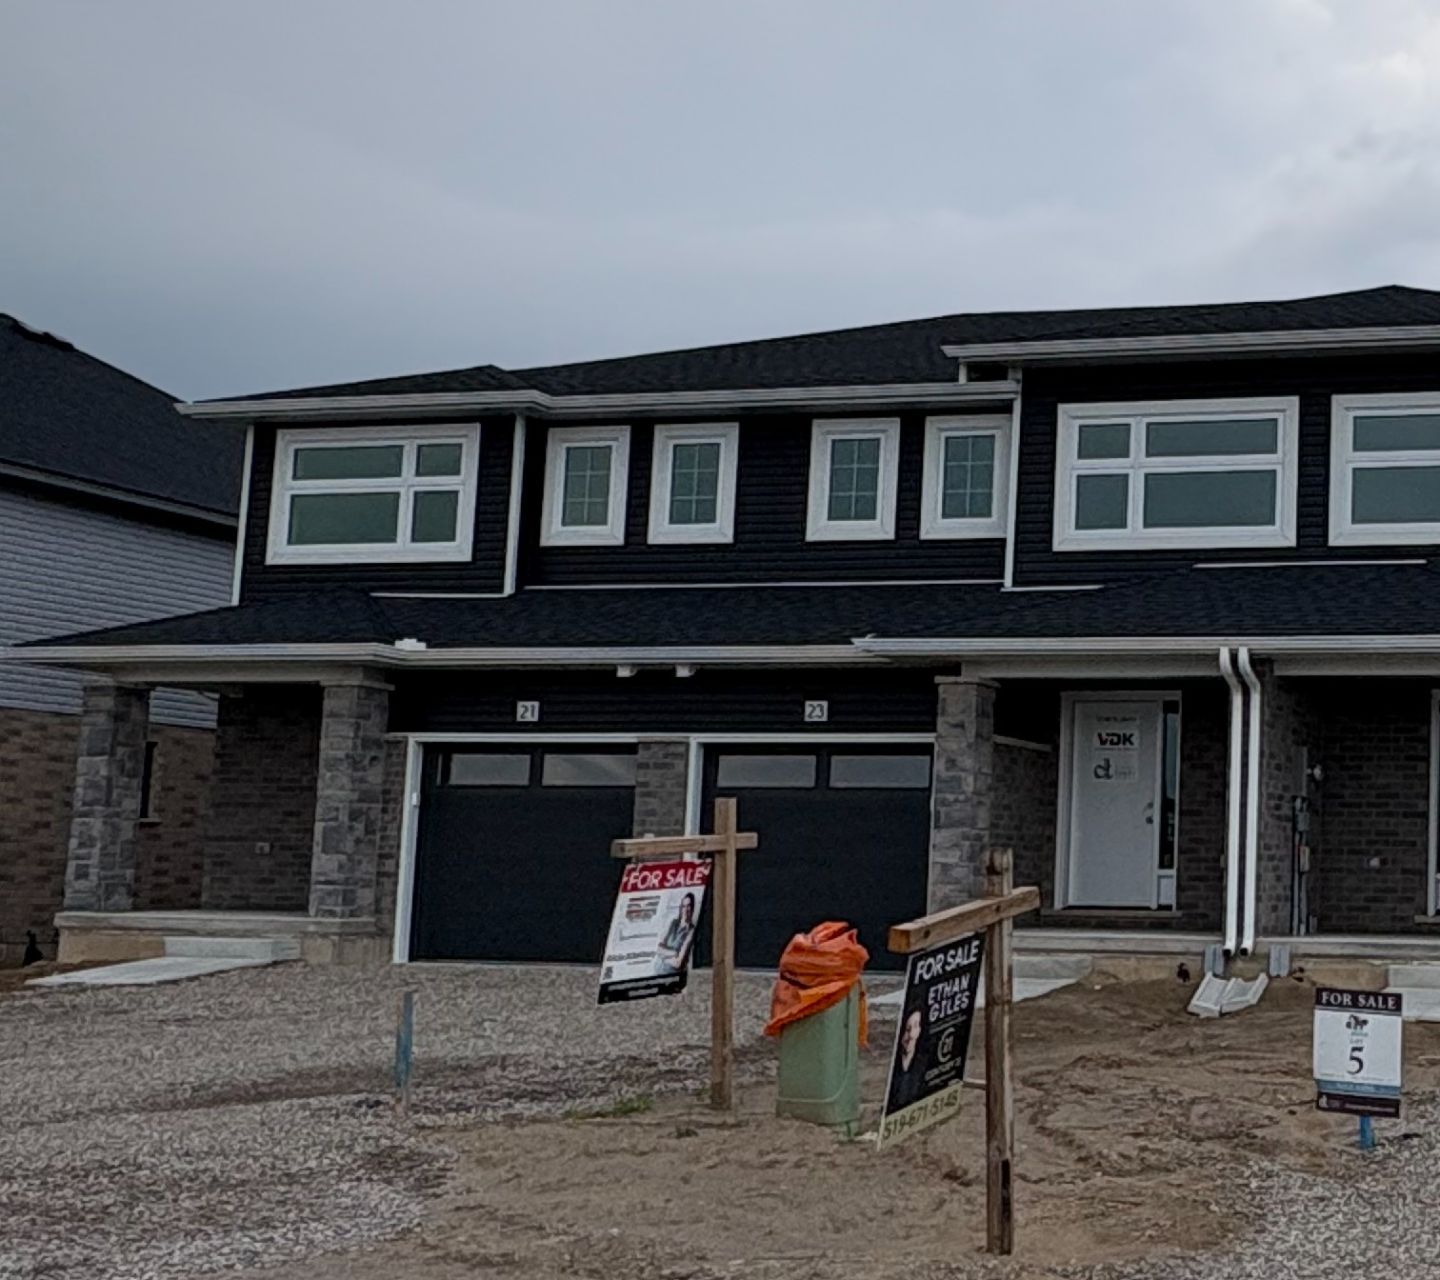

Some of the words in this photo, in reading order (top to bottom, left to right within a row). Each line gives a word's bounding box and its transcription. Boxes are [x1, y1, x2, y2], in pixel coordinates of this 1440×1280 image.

[520, 704, 536, 719] 21
[807, 704, 825, 719] 23
[1097, 732, 1135, 746] VDK
[626, 870, 662, 890] FOR
[664, 867, 704, 887] SALE
[914, 953, 945, 984] FOR
[945, 940, 980, 971] SALE
[928, 973, 970, 1005] ETHAN
[1321, 991, 1353, 1006] FOR
[1357, 994, 1397, 1009] SALE
[929, 991, 971, 1022] GILES
[1347, 1046, 1364, 1075] 5
